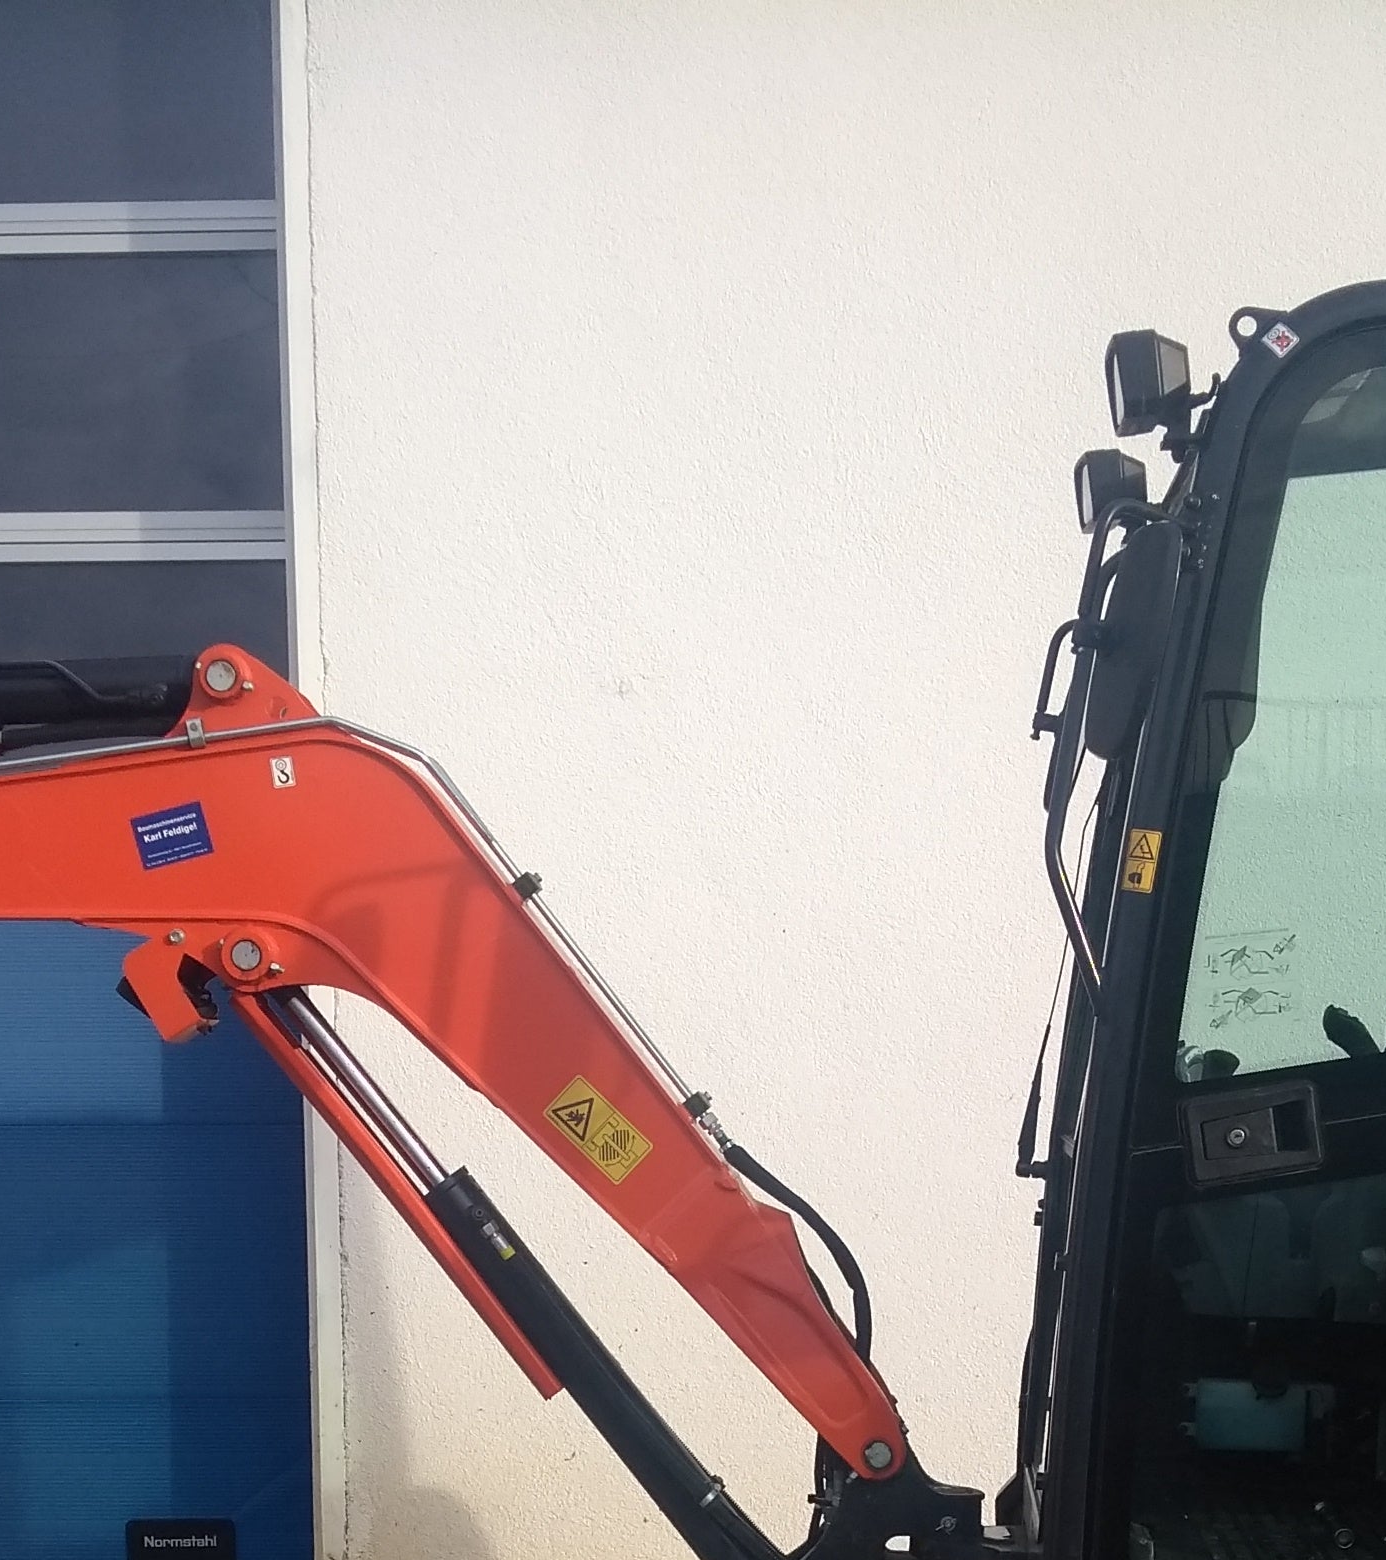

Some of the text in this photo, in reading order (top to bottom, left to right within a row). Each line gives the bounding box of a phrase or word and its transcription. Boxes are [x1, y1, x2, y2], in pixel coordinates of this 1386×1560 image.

[143, 821, 198, 843] Karl Feldigel
[143, 1534, 217, 1548] Normstahl
